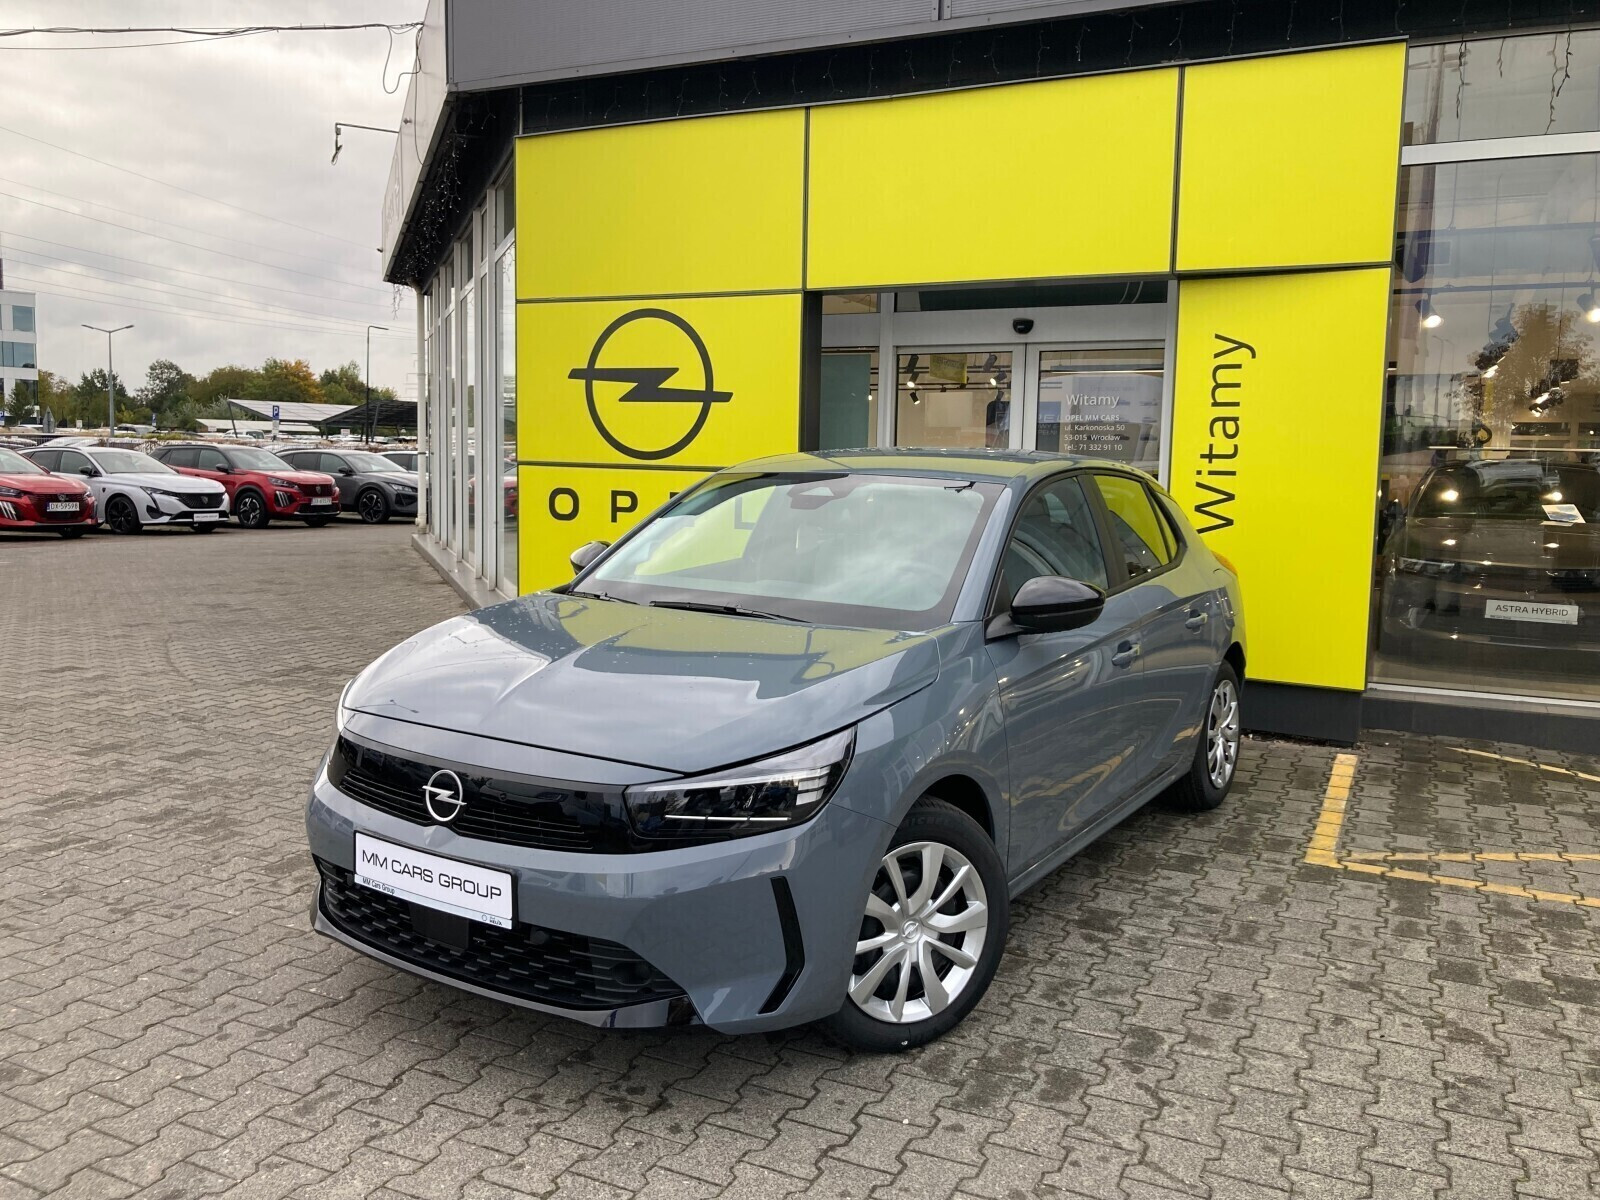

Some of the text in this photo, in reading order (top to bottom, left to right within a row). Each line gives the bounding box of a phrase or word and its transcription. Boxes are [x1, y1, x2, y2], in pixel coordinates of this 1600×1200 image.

[1066, 394, 1120, 408] Witamy
[1194, 333, 1256, 534] Witamy
[1495, 604, 1569, 617] ASTRA HYBRID
[362, 849, 502, 900] MM CARS GROUP
[362, 876, 396, 896] MM Cars Group
